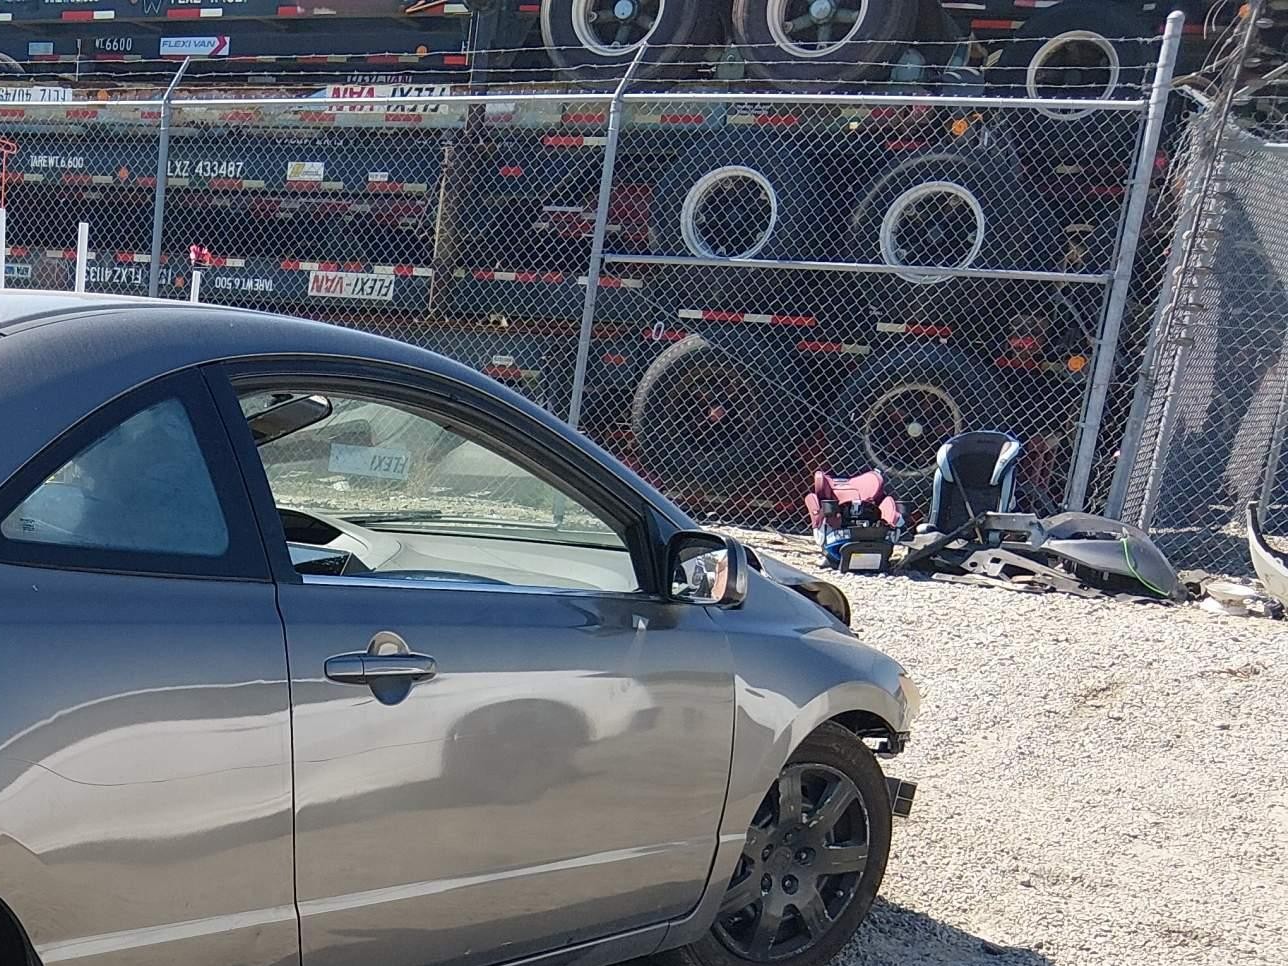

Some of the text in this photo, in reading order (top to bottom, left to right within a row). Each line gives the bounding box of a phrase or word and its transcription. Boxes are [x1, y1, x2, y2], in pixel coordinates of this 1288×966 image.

[162, 40, 215, 48] FLEXI VAN
[195, 160, 244, 178] 433487
